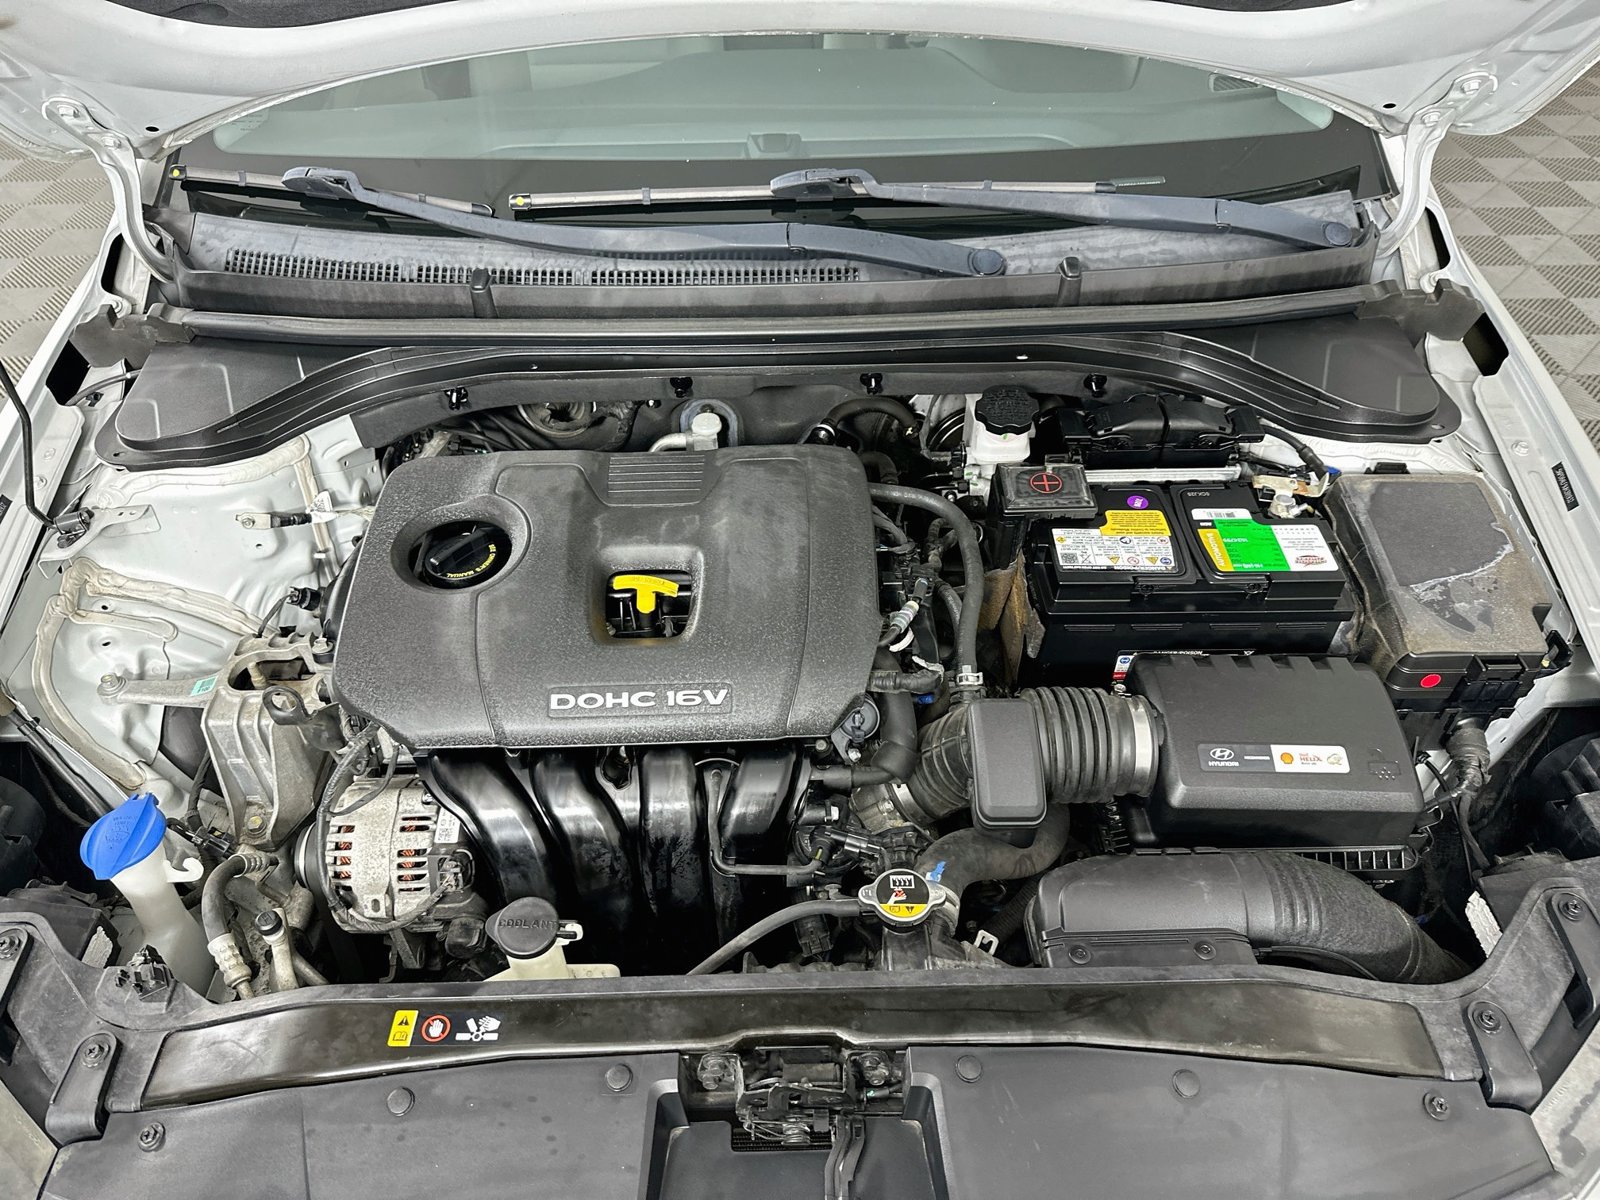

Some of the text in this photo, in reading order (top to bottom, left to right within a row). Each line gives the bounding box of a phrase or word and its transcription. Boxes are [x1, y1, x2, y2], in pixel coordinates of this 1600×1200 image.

[447, 570, 475, 578] MANUAL
[550, 689, 728, 710] DOHC 16V
[498, 919, 557, 931] COOLANT
